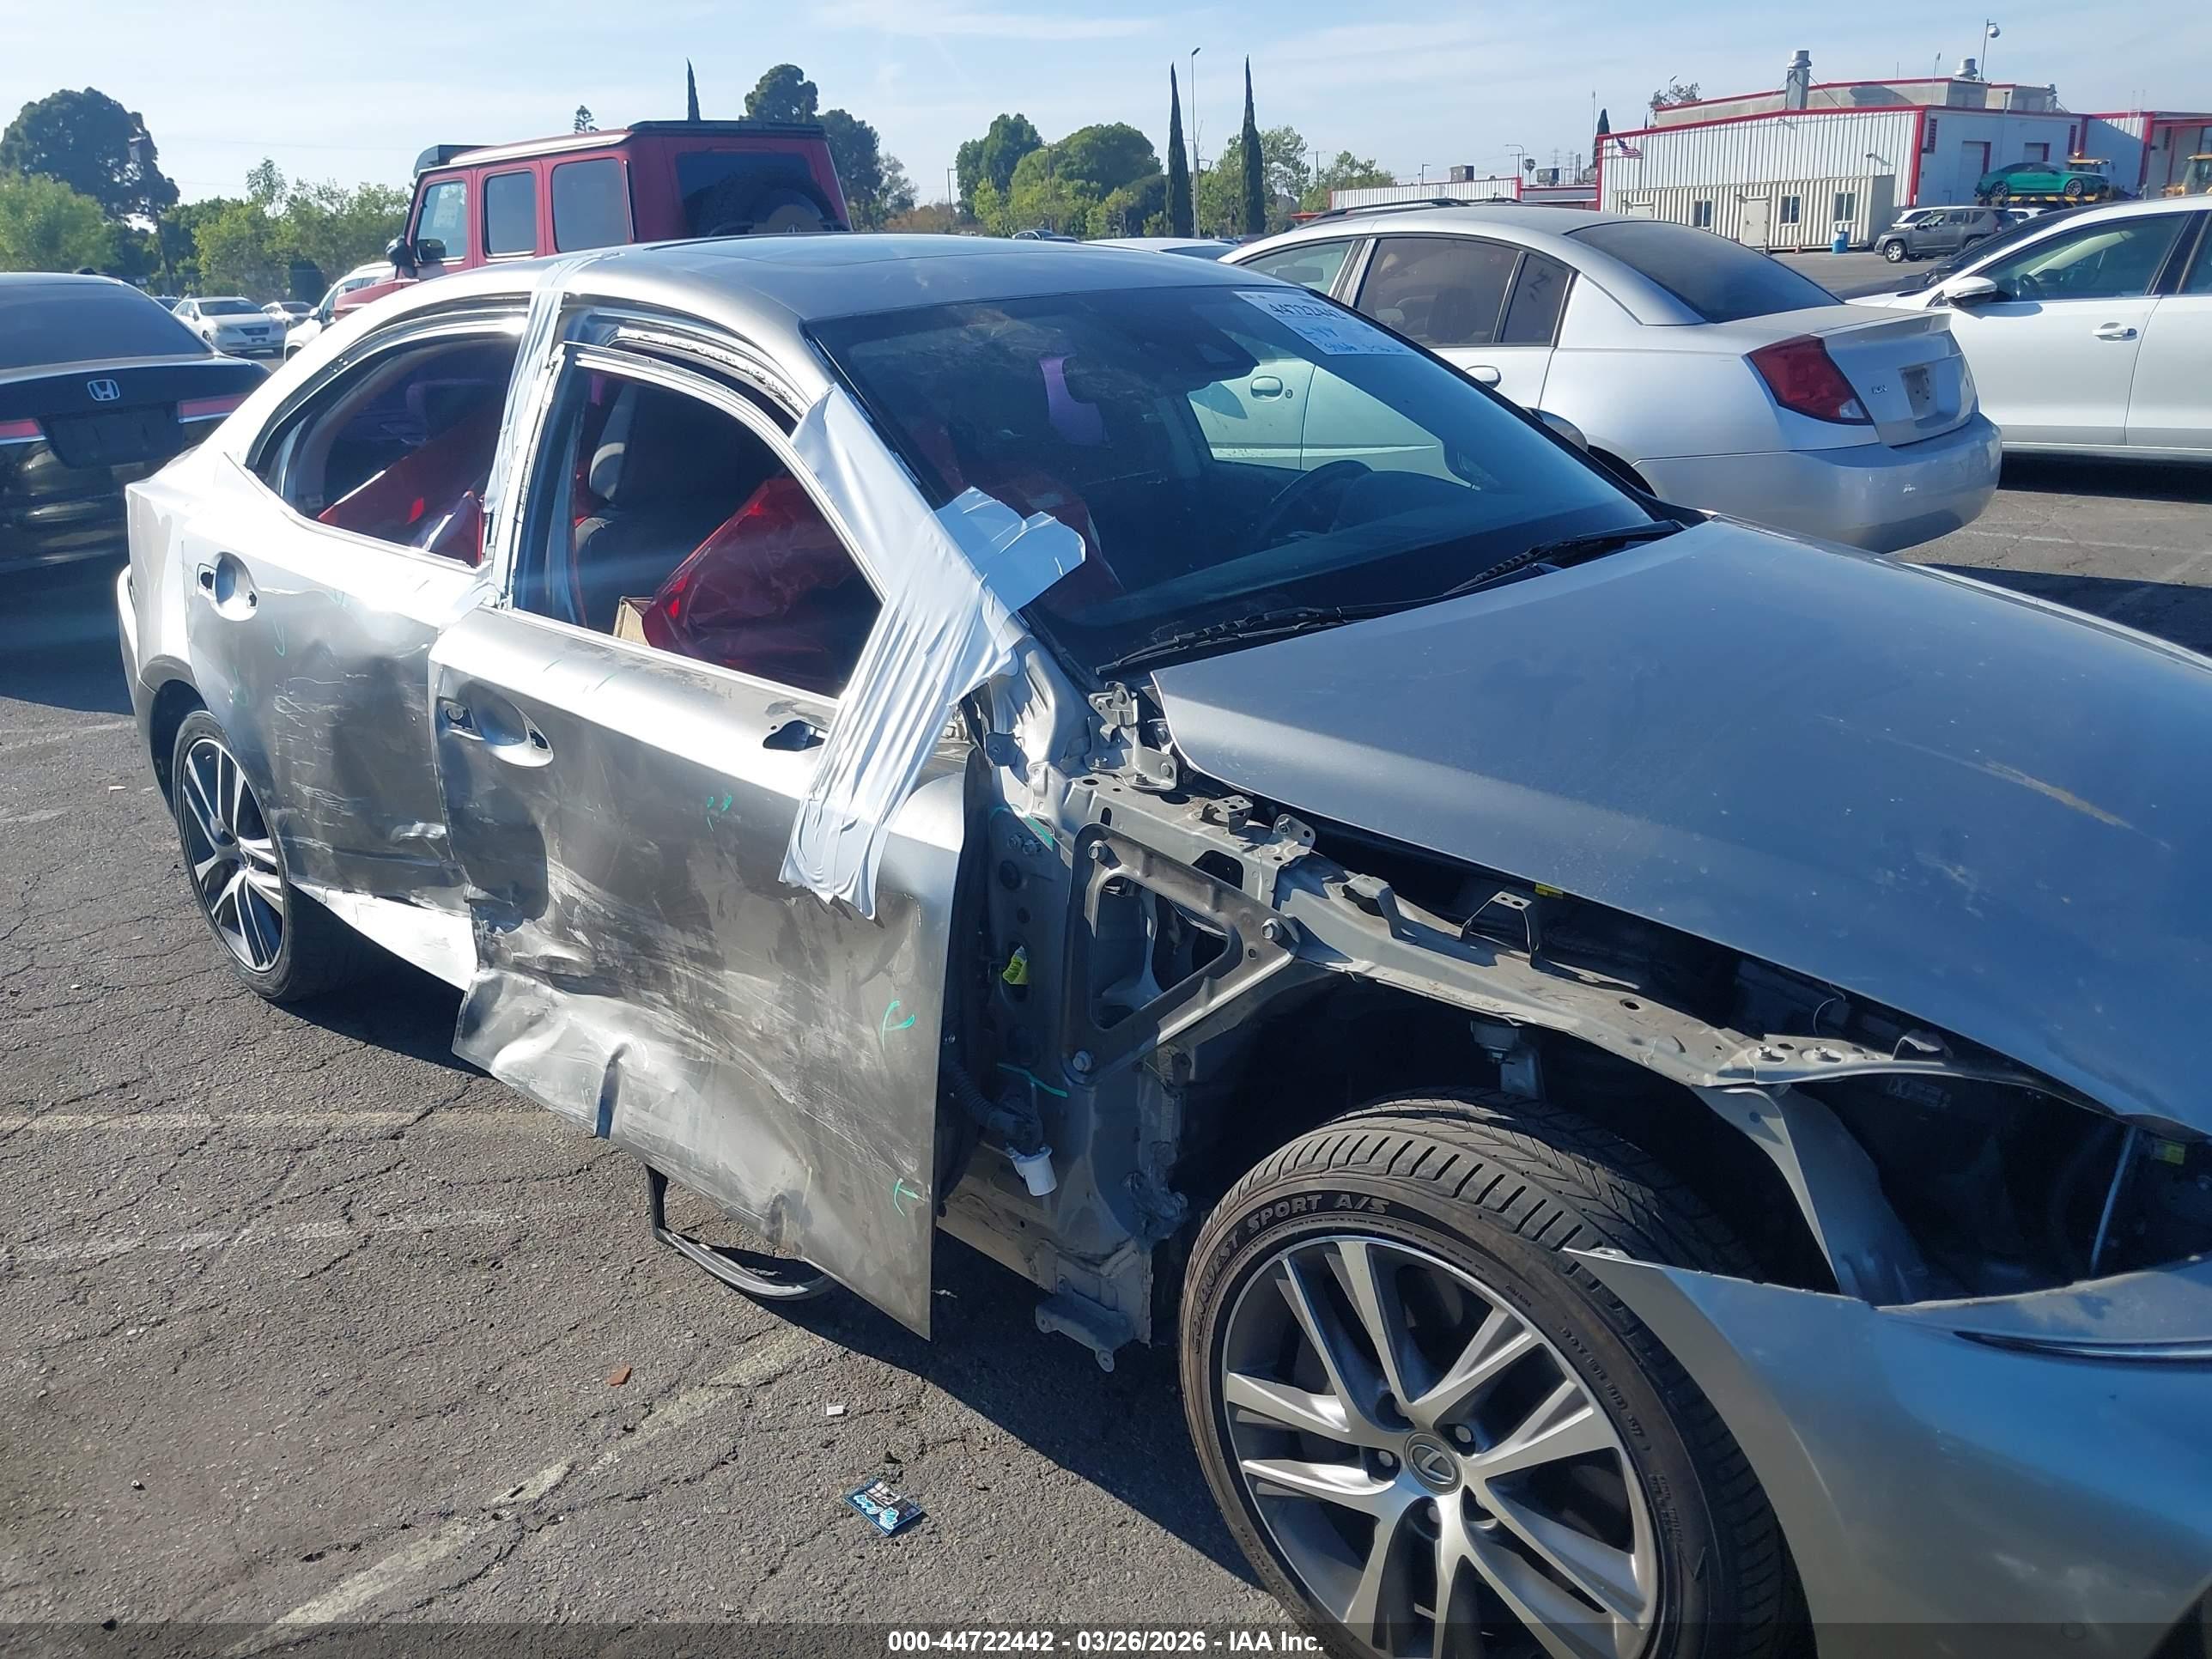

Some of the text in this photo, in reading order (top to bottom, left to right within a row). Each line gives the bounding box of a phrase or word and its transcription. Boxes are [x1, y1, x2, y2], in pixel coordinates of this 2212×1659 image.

[1268, 303, 1347, 320] 44722442
[1247, 1194, 1323, 1235] SPORT
[1334, 1194, 1390, 1214] A/S
